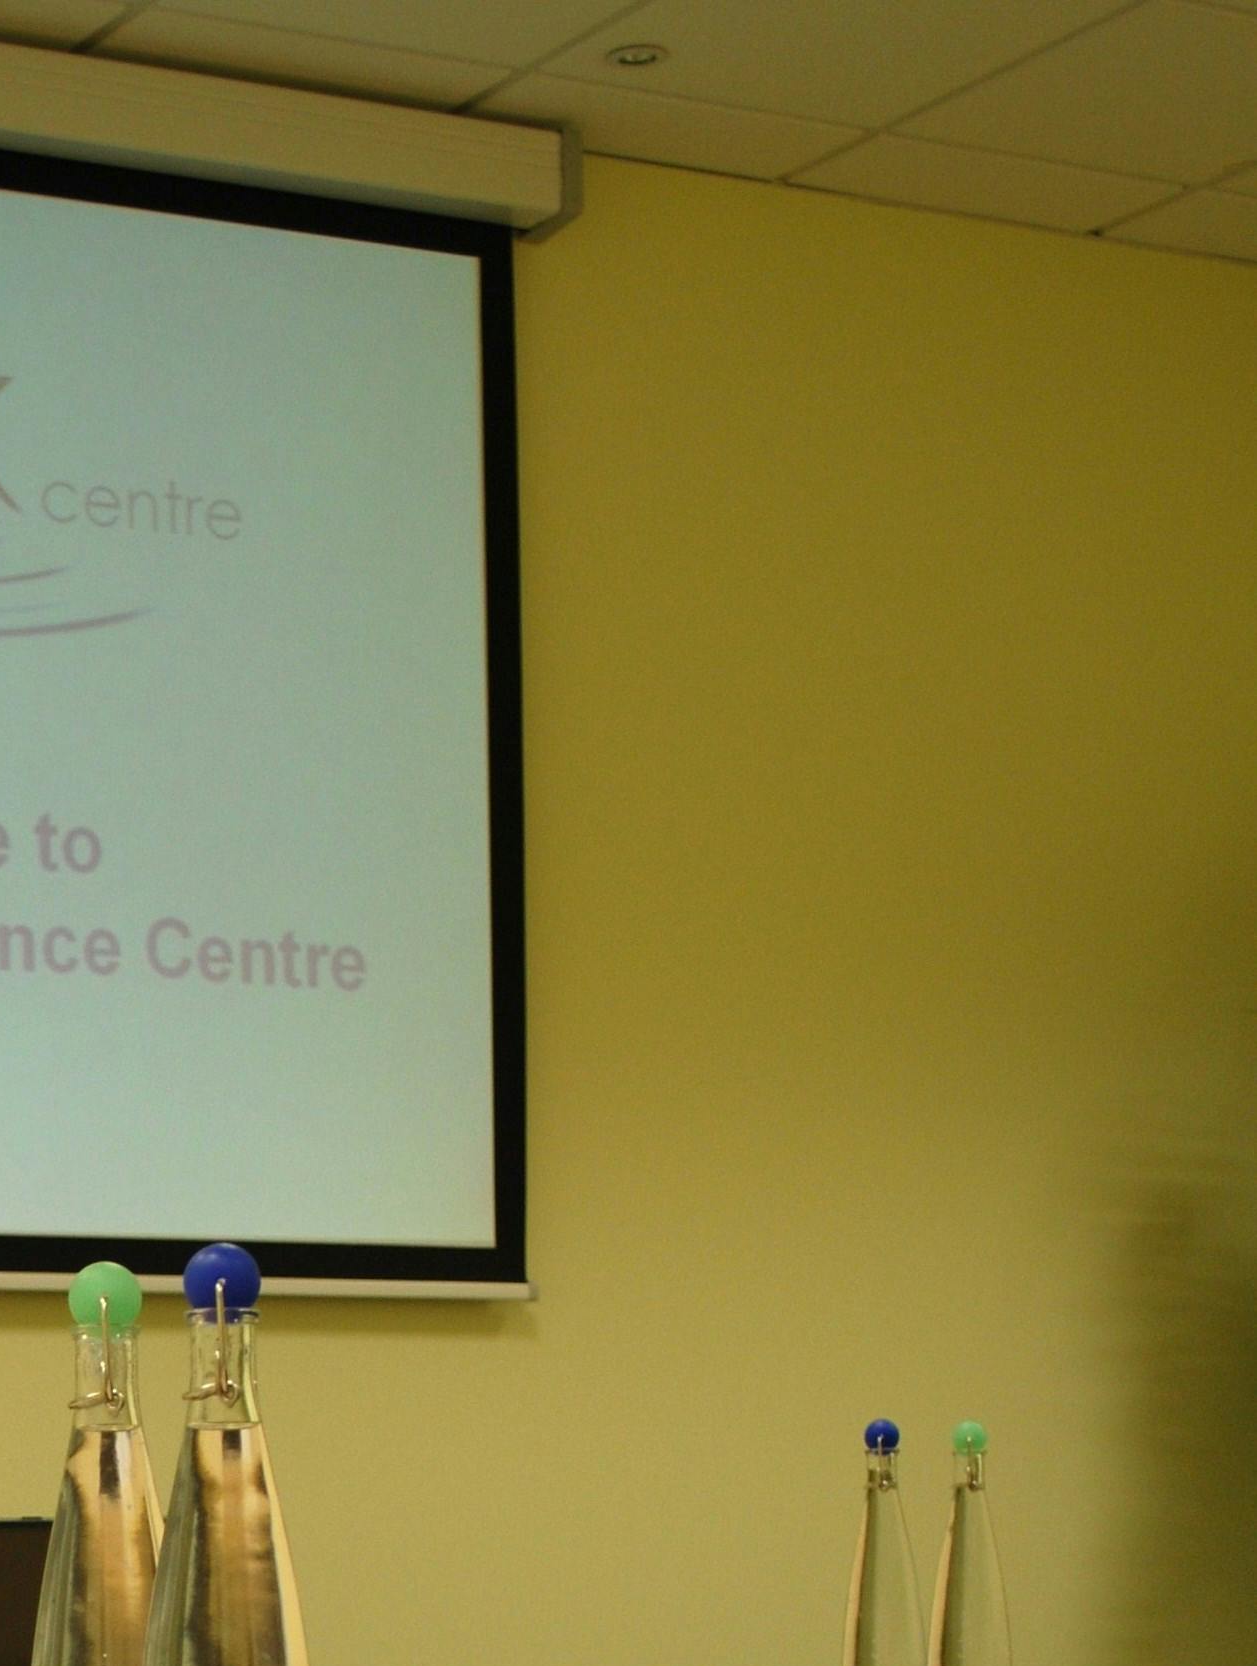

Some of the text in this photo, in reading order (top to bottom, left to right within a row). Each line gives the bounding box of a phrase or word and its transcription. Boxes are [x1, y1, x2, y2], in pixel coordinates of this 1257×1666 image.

[41, 480, 243, 541] centre
[33, 808, 103, 874] to
[145, 916, 368, 994] Centre
